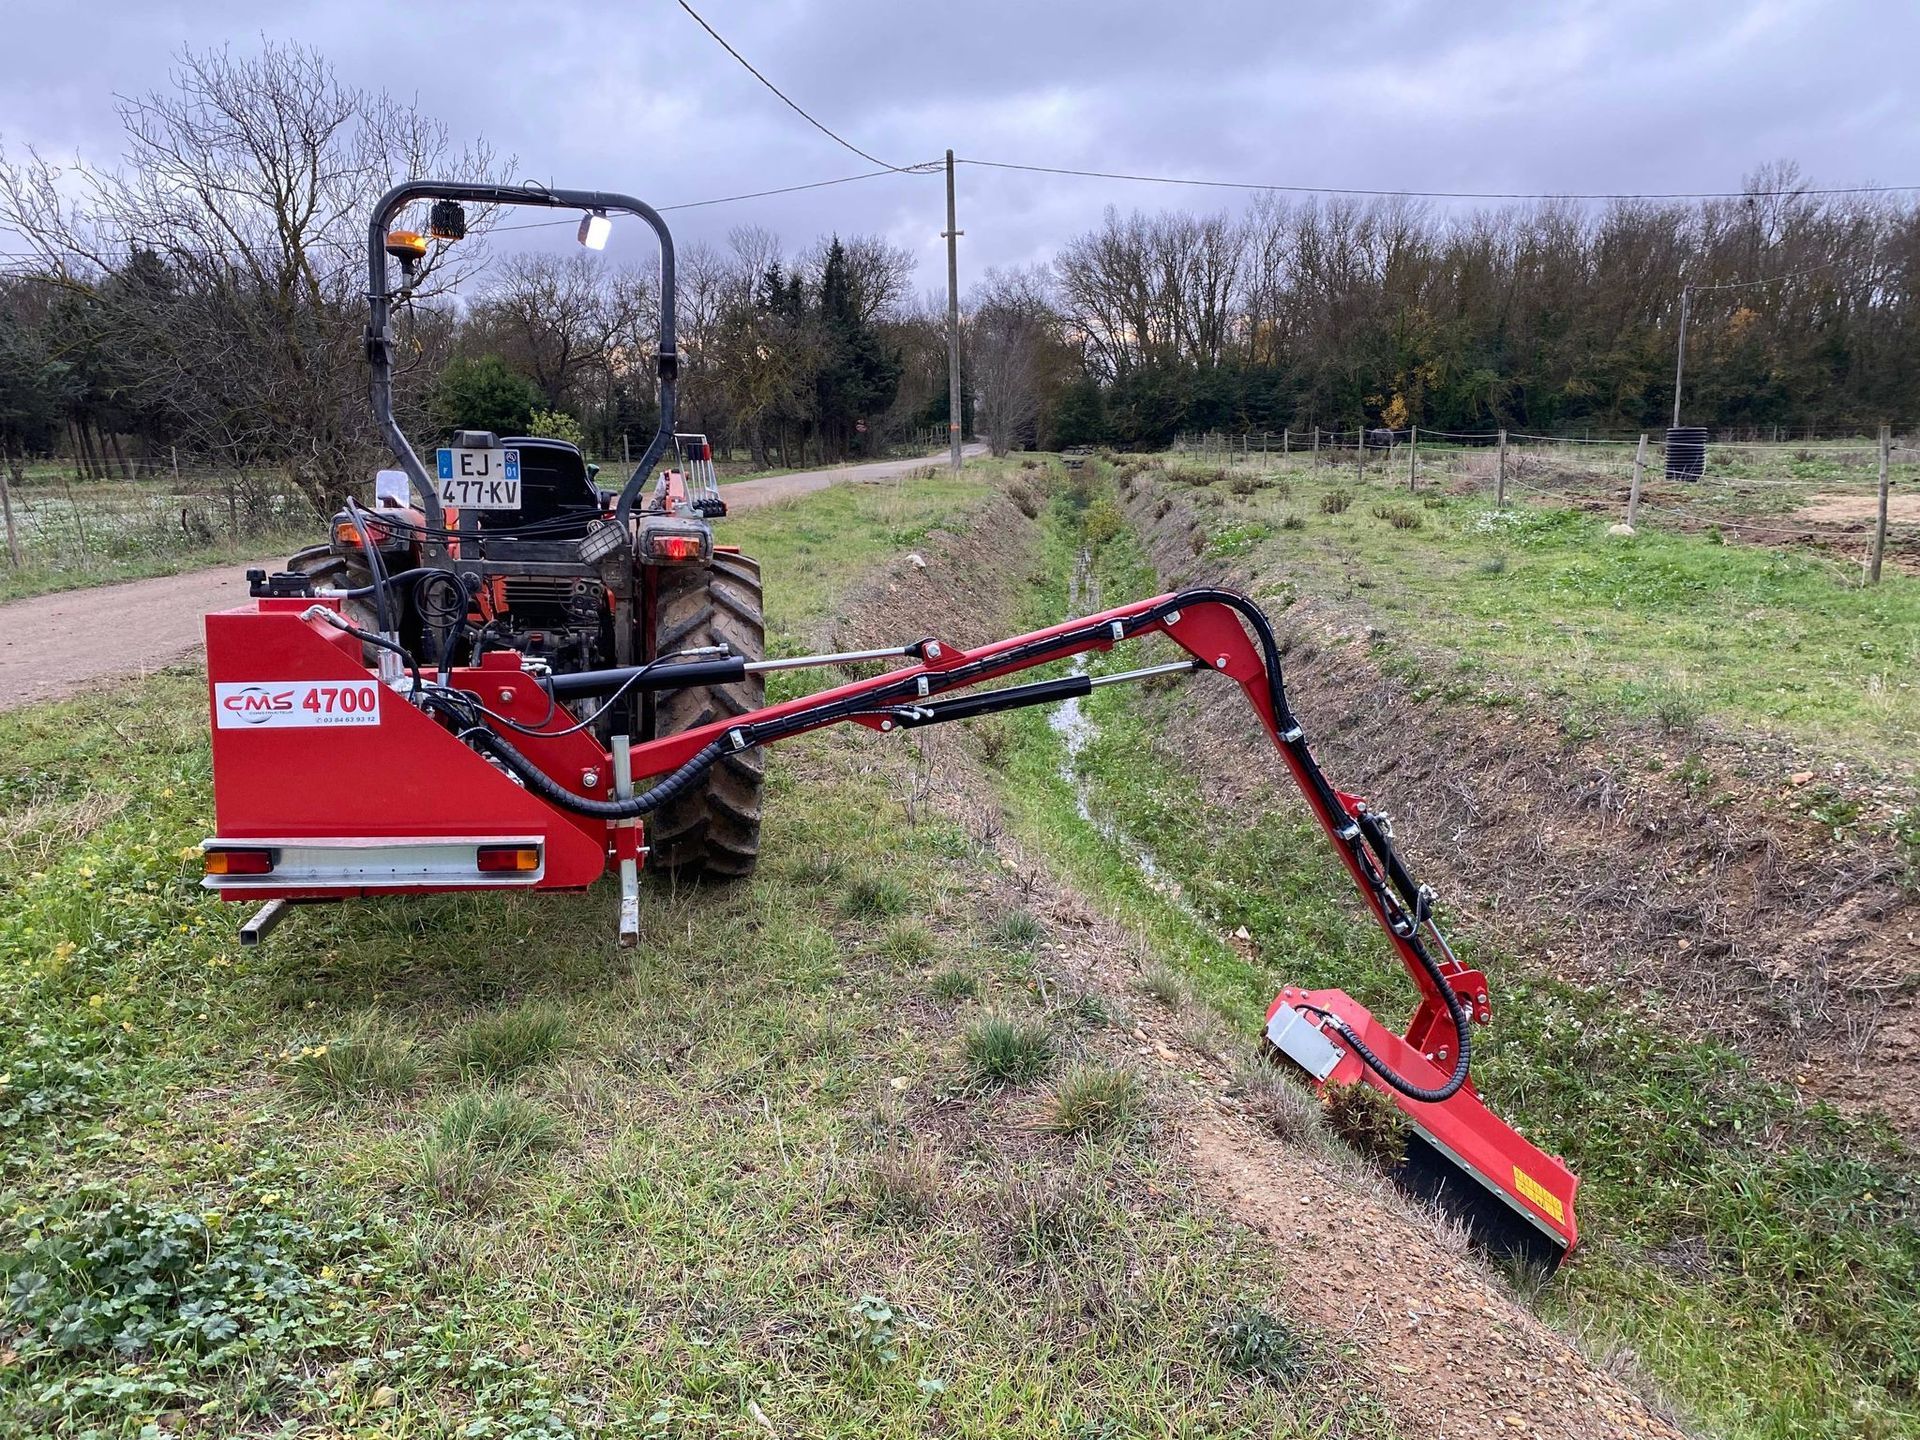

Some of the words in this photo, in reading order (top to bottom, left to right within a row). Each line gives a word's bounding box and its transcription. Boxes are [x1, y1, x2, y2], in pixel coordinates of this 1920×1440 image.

[443, 467, 449, 475] F
[506, 467, 517, 477] 01
[443, 481, 517, 503] 477-KV
[223, 690, 295, 711] CMS
[303, 687, 376, 713] 4700
